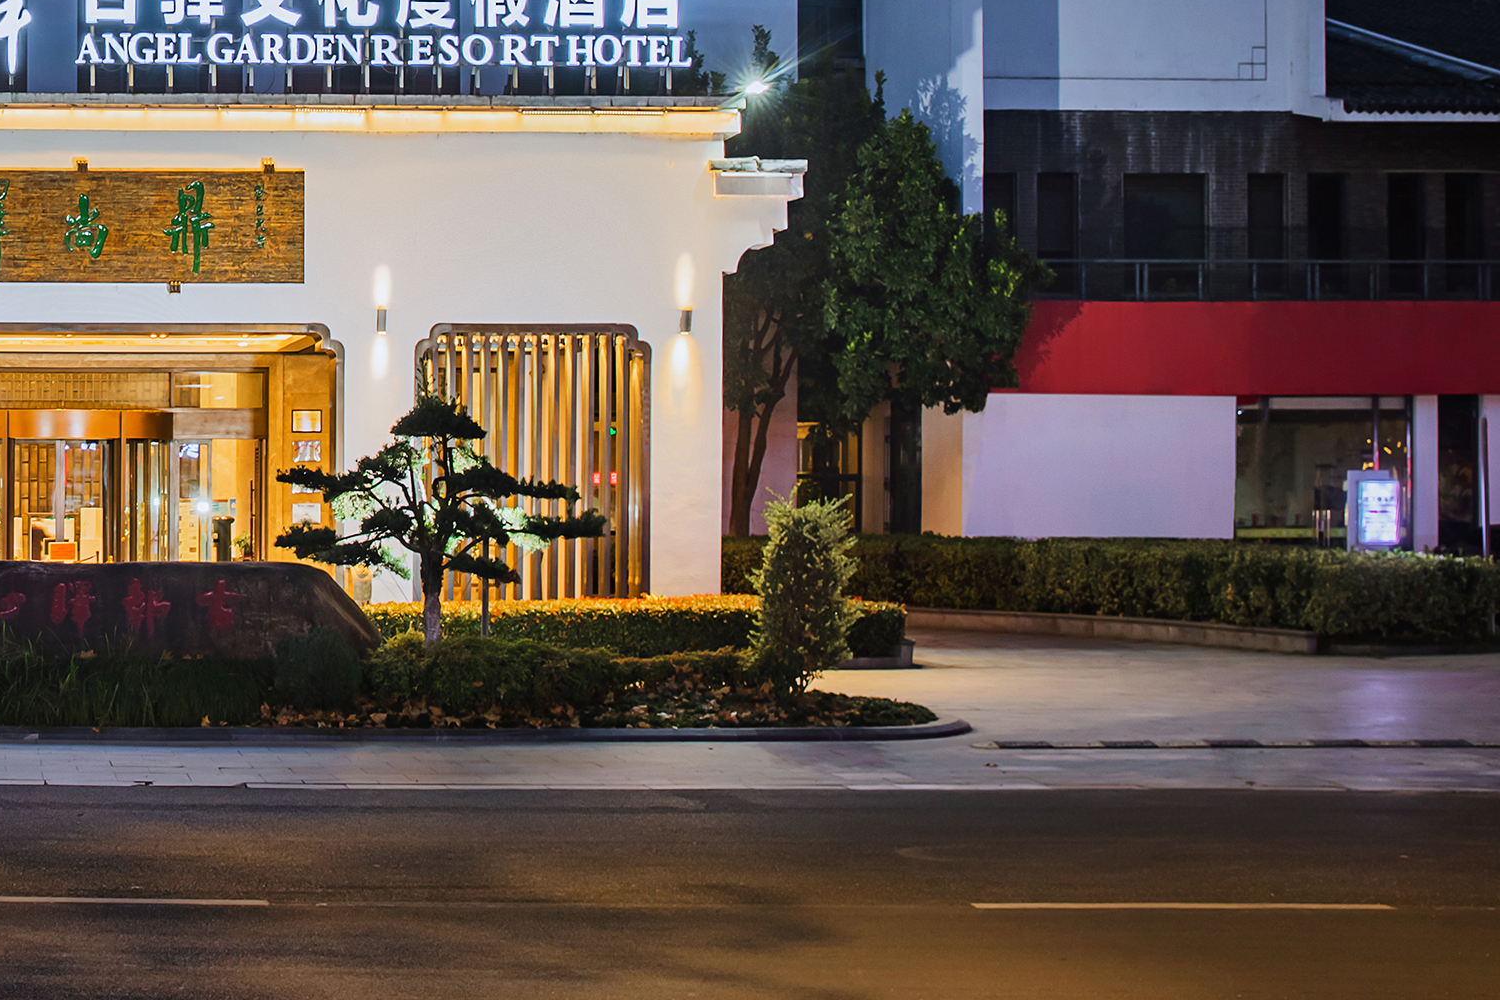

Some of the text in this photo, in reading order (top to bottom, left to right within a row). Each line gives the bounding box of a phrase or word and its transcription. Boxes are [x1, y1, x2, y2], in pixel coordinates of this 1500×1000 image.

[75, 33, 692, 69] ANGEL GARDEN RESORT HOTEL
